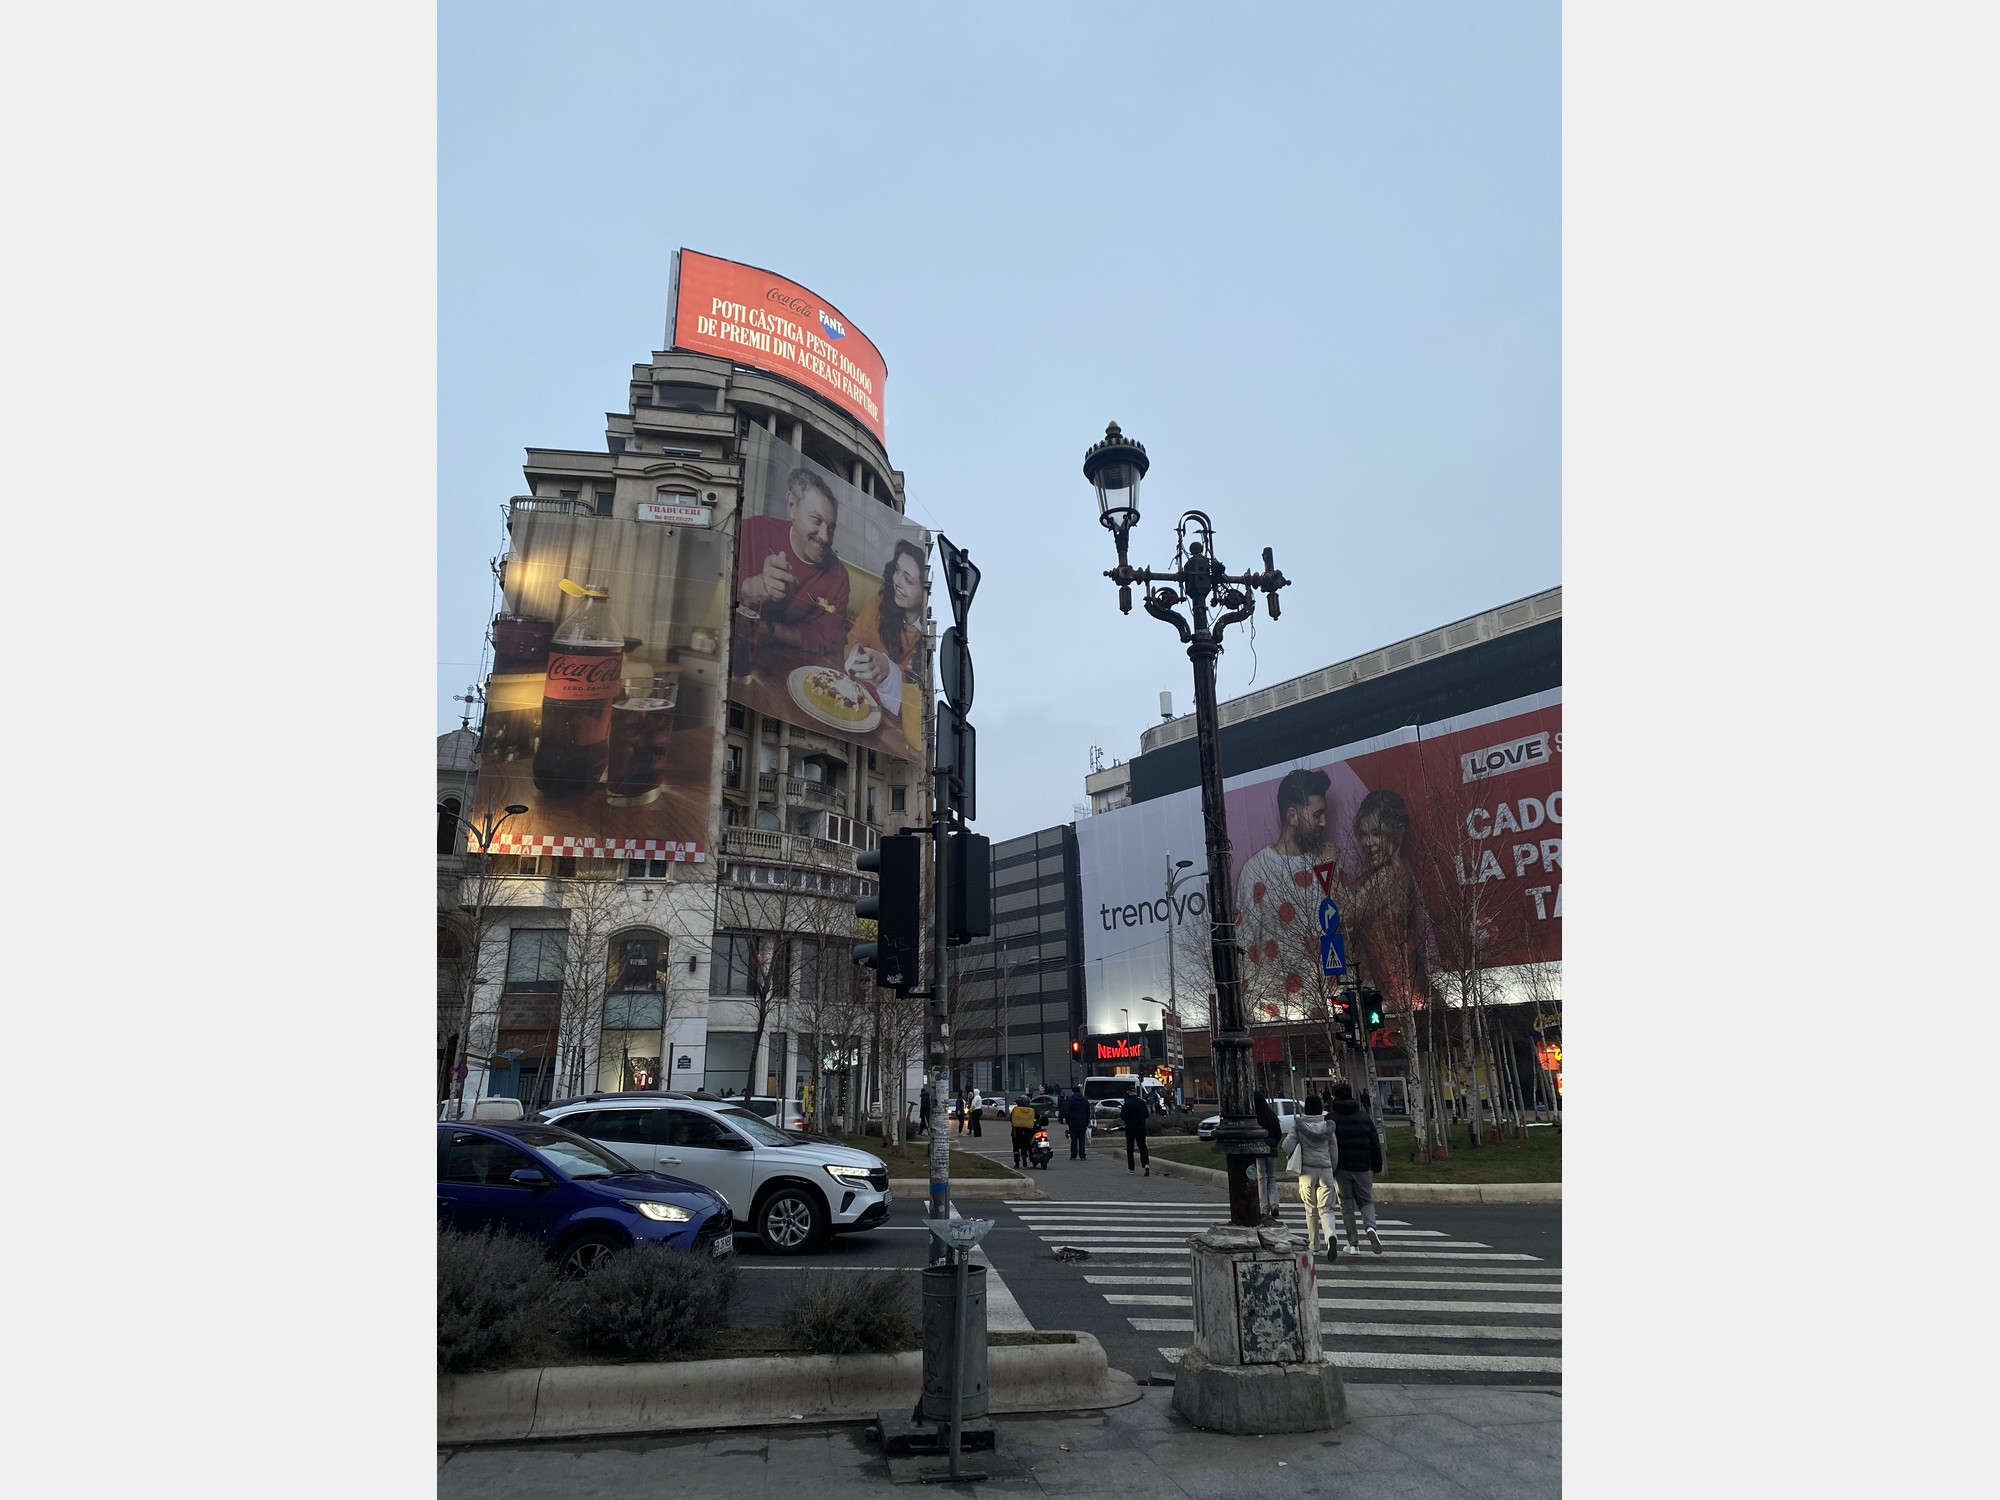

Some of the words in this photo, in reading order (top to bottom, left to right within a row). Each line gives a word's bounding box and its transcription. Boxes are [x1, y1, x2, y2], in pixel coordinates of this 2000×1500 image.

[819, 309, 846, 337] FANTA
[711, 297, 747, 324] POȚI
[749, 308, 804, 345] CÂȘTIGA
[806, 330, 839, 366] PESTE
[839, 353, 872, 395] 100.000
[697, 315, 718, 337] DE
[720, 321, 771, 352] PREMII
[773, 337, 796, 361] DIN
[842, 375, 879, 422] FARFURIE
[648, 505, 701, 516] TRADUCERI
[1470, 740, 1543, 775] LOVE
[1454, 849, 1506, 886] LA
